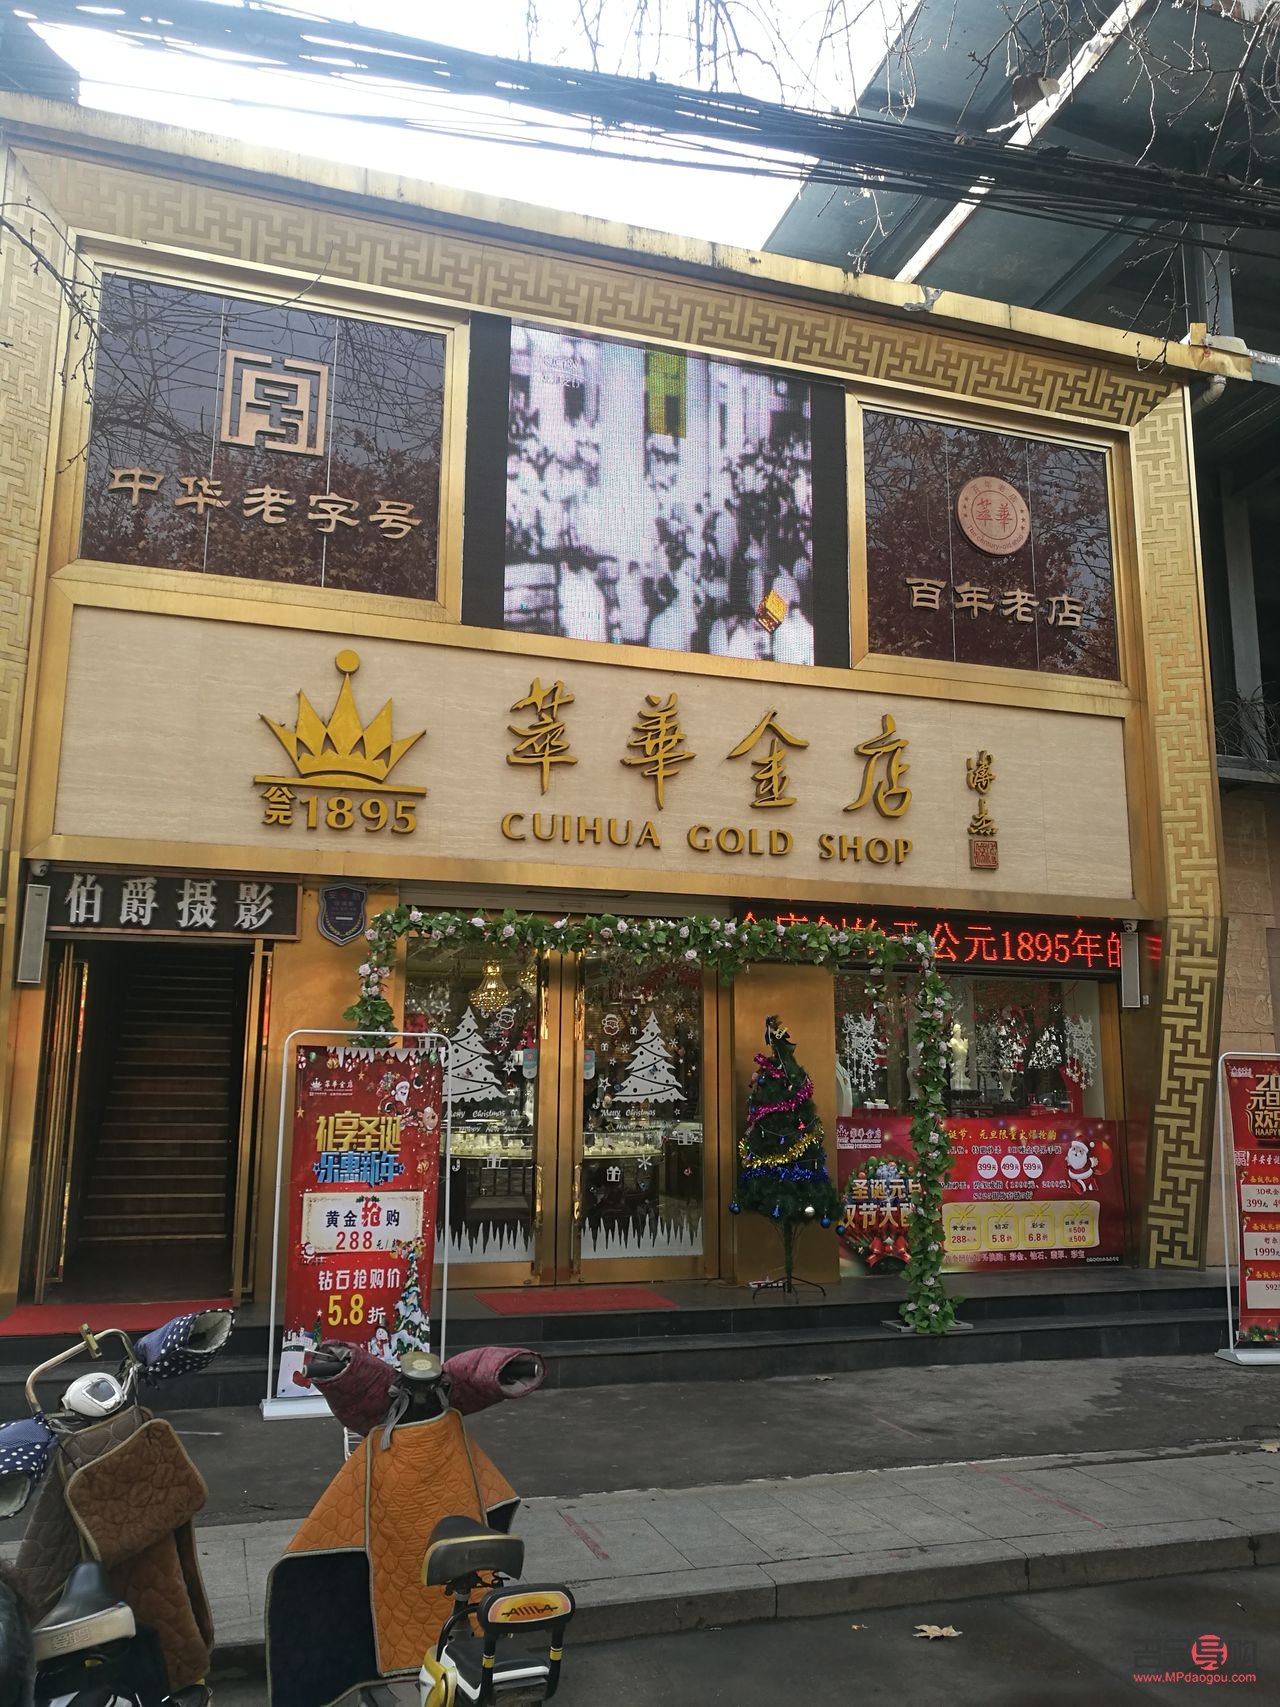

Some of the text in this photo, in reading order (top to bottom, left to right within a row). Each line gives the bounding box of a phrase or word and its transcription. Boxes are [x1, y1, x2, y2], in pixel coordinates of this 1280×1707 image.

[108, 466, 422, 540] 中华老字号
[905, 577, 1084, 628] 百年老店
[501, 812, 914, 864] CUIHUA GOLD SHOP
[64, 873, 275, 931] 伯爵摄影
[472, 1108, 506, 1118] Christmas
[625, 1108, 656, 1117] Christmas
[1246, 1091, 1280, 1112] 元旦
[315, 1110, 402, 1152] 礼享圣诞
[316, 1150, 401, 1187] 乐惠新年
[326, 1196, 400, 1228] 黄金抢购
[318, 1267, 401, 1291] 钻石抢购价
